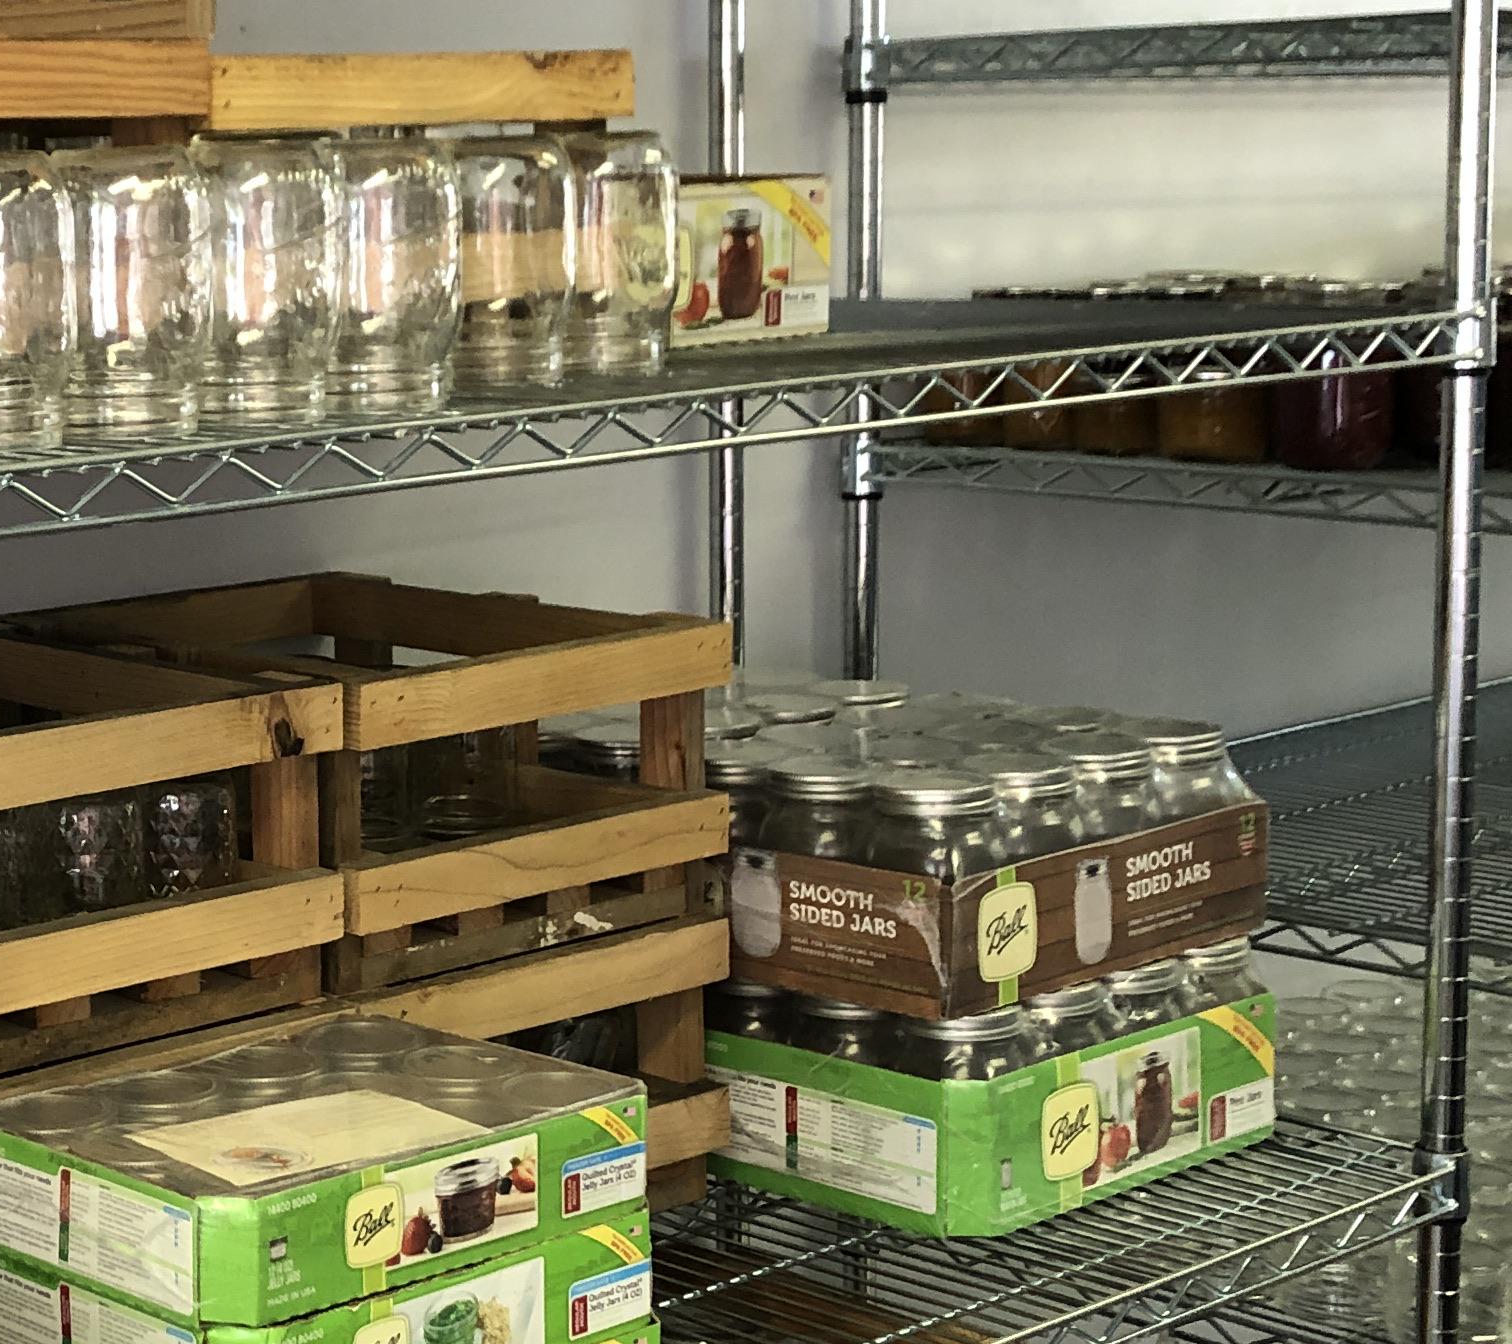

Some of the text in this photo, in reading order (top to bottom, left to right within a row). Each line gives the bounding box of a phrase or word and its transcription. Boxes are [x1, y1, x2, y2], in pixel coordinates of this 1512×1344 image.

[1126, 841, 1194, 878] SMOOTH
[789, 880, 874, 912] SMOOTH
[902, 879, 927, 901] 12
[1126, 861, 1212, 903] SIDED JARS
[789, 902, 898, 939] SIDED JARS
[986, 904, 1029, 956] Ball
[1049, 1103, 1091, 1156] Ball
[352, 1201, 395, 1247] Ball
